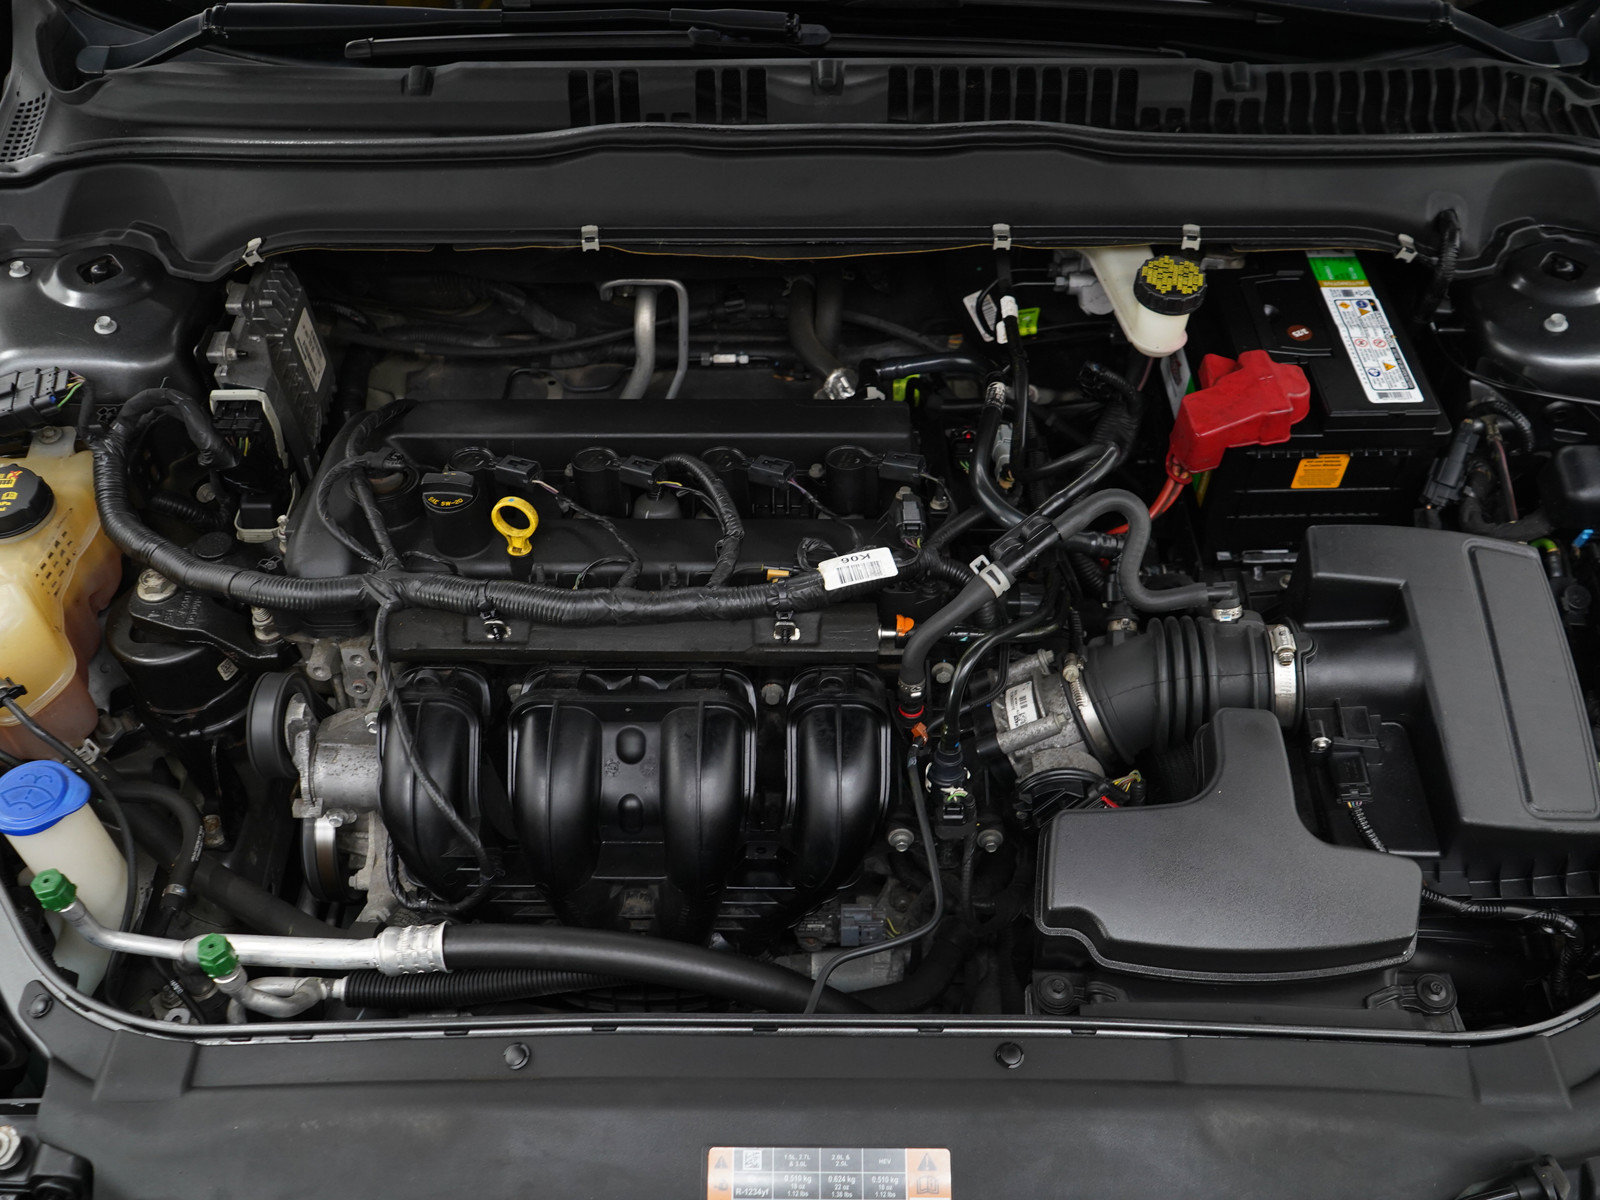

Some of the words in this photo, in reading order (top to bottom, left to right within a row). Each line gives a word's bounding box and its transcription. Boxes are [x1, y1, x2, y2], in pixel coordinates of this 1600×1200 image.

[428, 496, 440, 505] SAE
[440, 498, 464, 506] 5W-20
[841, 553, 870, 563] K06
[803, 1175, 812, 1184] kg
[847, 1176, 856, 1185] kg
[890, 1176, 899, 1185] kg
[735, 1187, 769, 1198] R-1234yf
